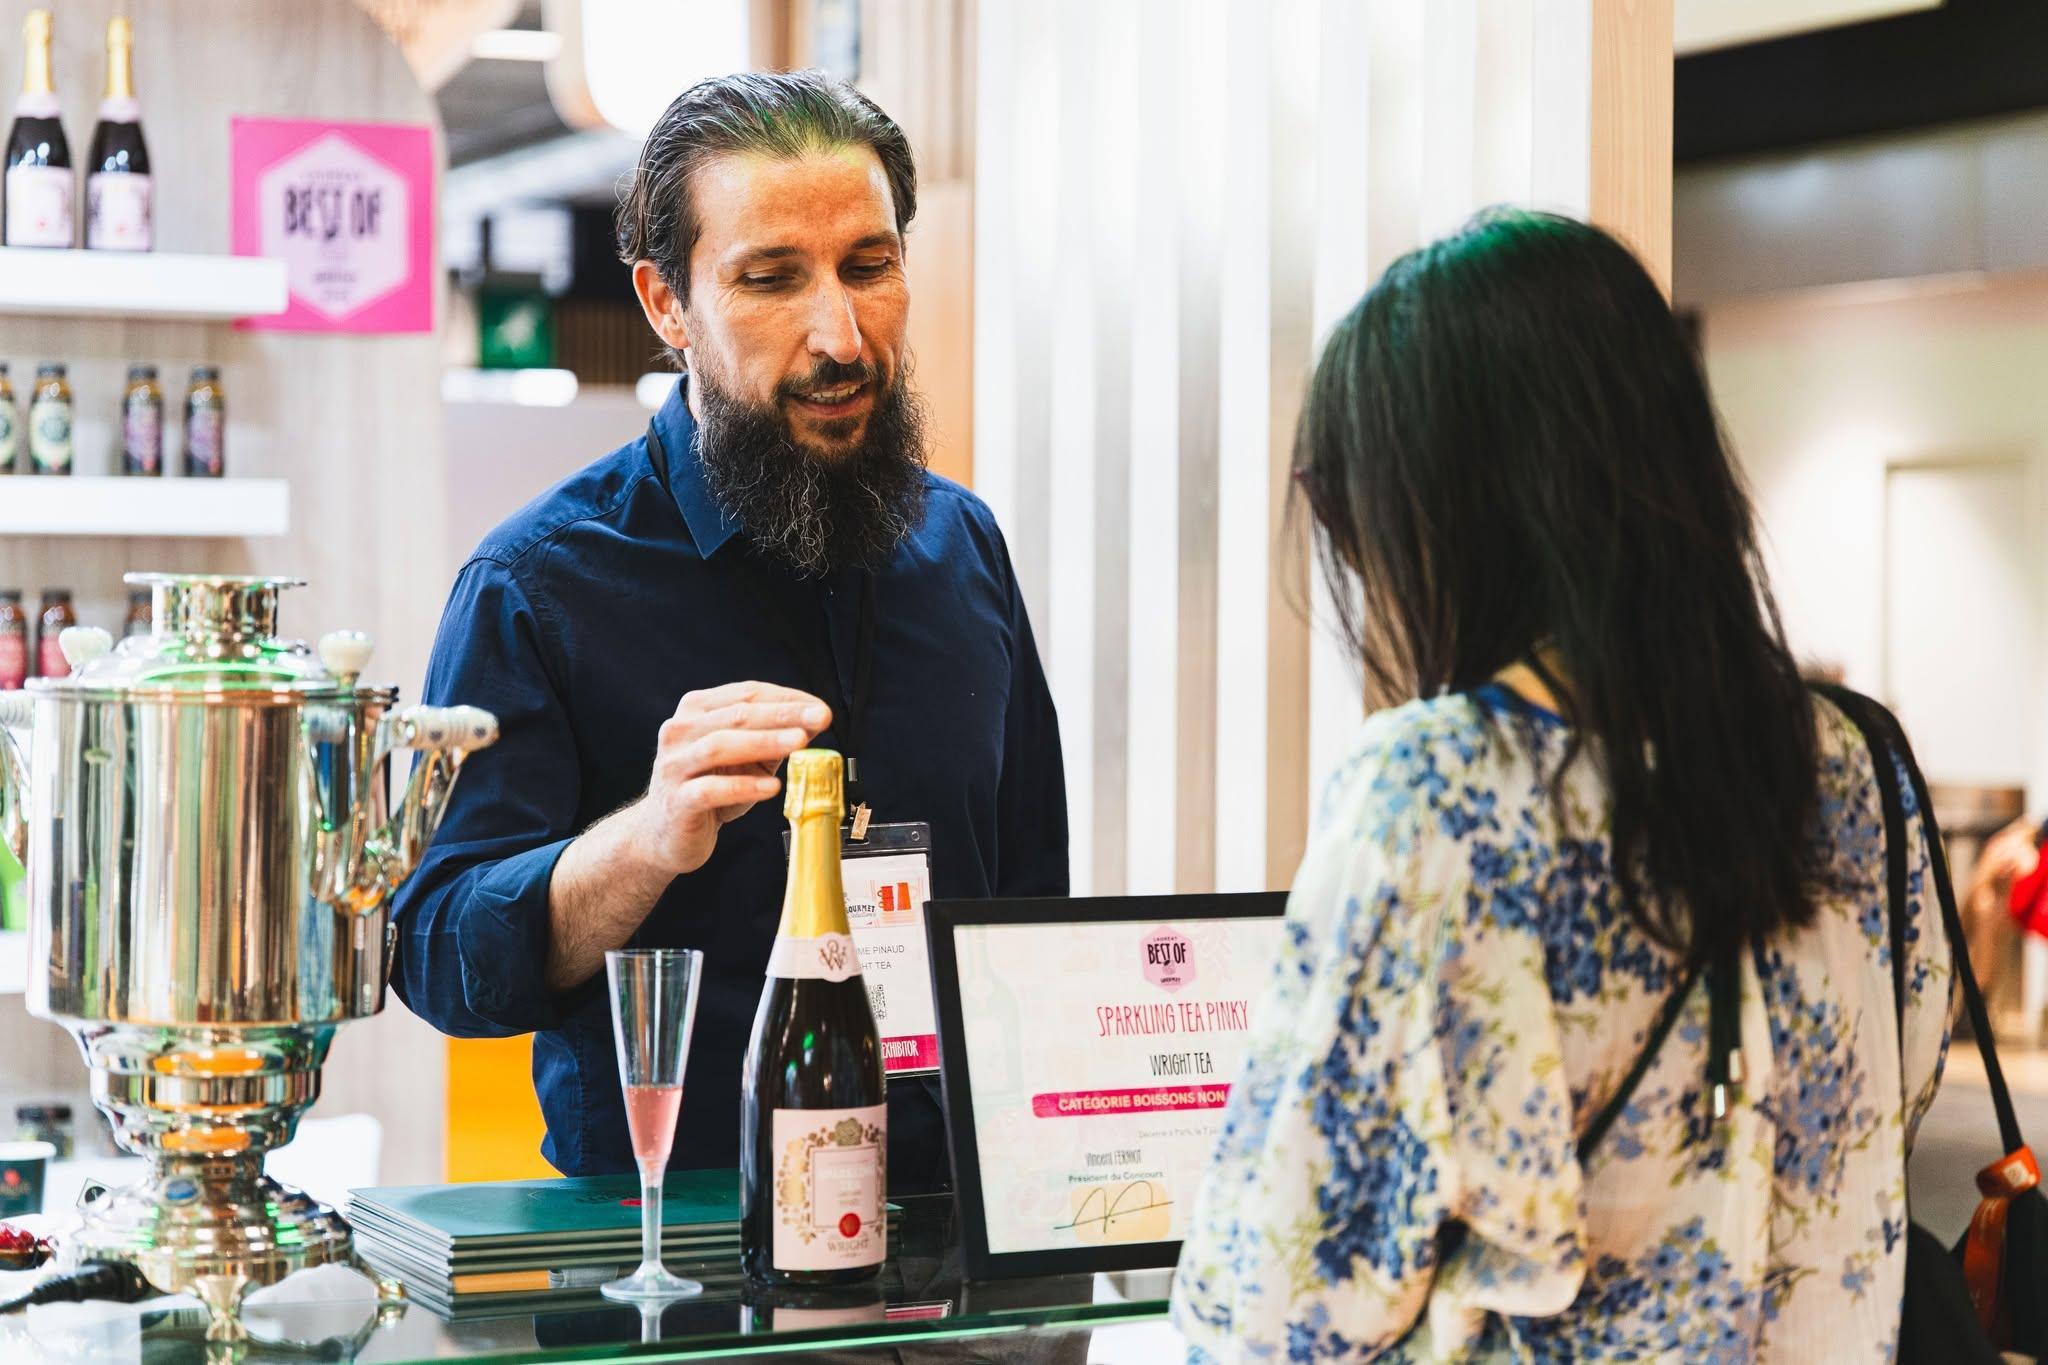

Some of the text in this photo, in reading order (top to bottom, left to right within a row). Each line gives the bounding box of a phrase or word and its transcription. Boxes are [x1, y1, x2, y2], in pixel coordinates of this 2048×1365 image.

[285, 184, 382, 241] BEST OF
[857, 944, 905, 955] ME PINAUD
[1147, 943, 1186, 966] BEST OF
[860, 961, 892, 970] HT TEA
[1096, 1000, 1249, 1037] SPARKLING TEA PINKY
[881, 1040, 919, 1058] EXHIBITOR
[1149, 1052, 1214, 1076] WRIGHT TEA
[1058, 1090, 1226, 1111] CATÉGORIE BOISSONS NON
[1111, 1173, 1121, 1181] du
[1123, 1171, 1164, 1181] Concours
